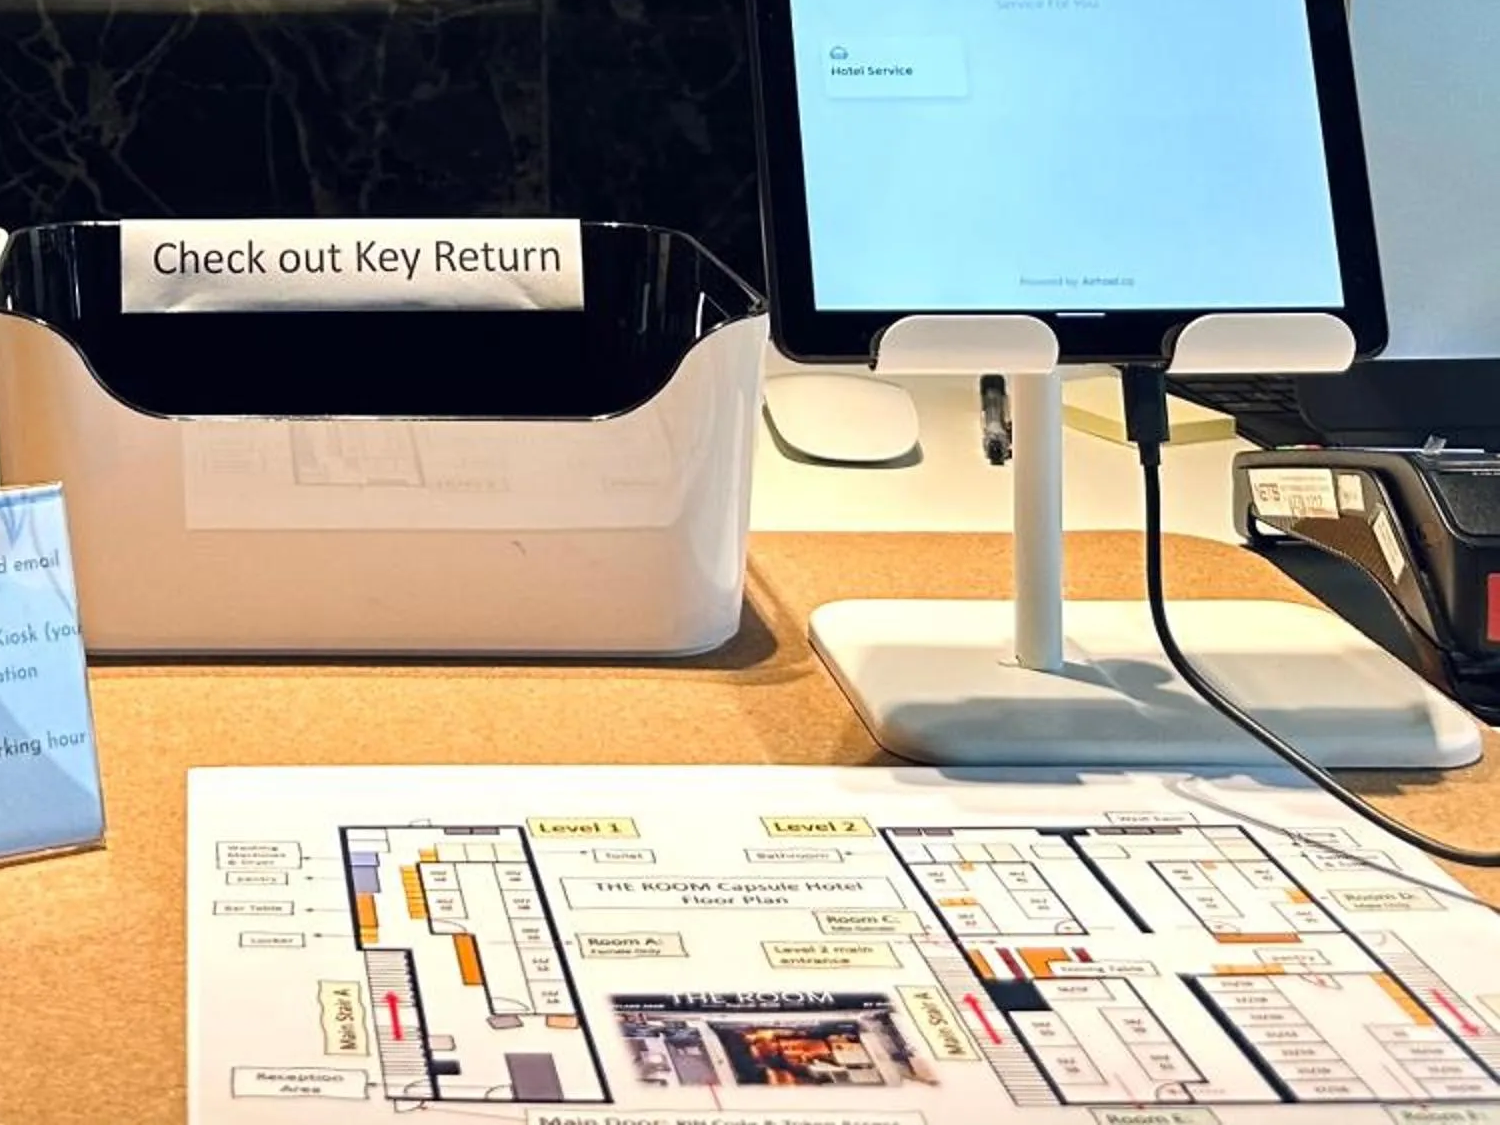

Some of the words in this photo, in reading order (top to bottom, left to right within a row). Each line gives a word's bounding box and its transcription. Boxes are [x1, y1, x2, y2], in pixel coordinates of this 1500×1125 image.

[831, 65, 865, 76] Hotel
[867, 65, 914, 76] Service
[153, 240, 267, 276] Check
[279, 248, 343, 276] out
[356, 240, 421, 281] Key
[434, 239, 562, 274] Return
[13, 548, 61, 576] email
[46, 731, 86, 750] hour
[538, 821, 599, 835] Level
[609, 822, 622, 834] 1
[773, 820, 834, 833] Level
[843, 820, 858, 832] 2
[596, 881, 638, 892] THE
[717, 881, 798, 894] Capsule
[805, 880, 864, 892] Hotel
[681, 895, 737, 905] Floor
[743, 895, 790, 905] Plan
[734, 990, 836, 1004] ROOM
[340, 1025, 357, 1050] Main
